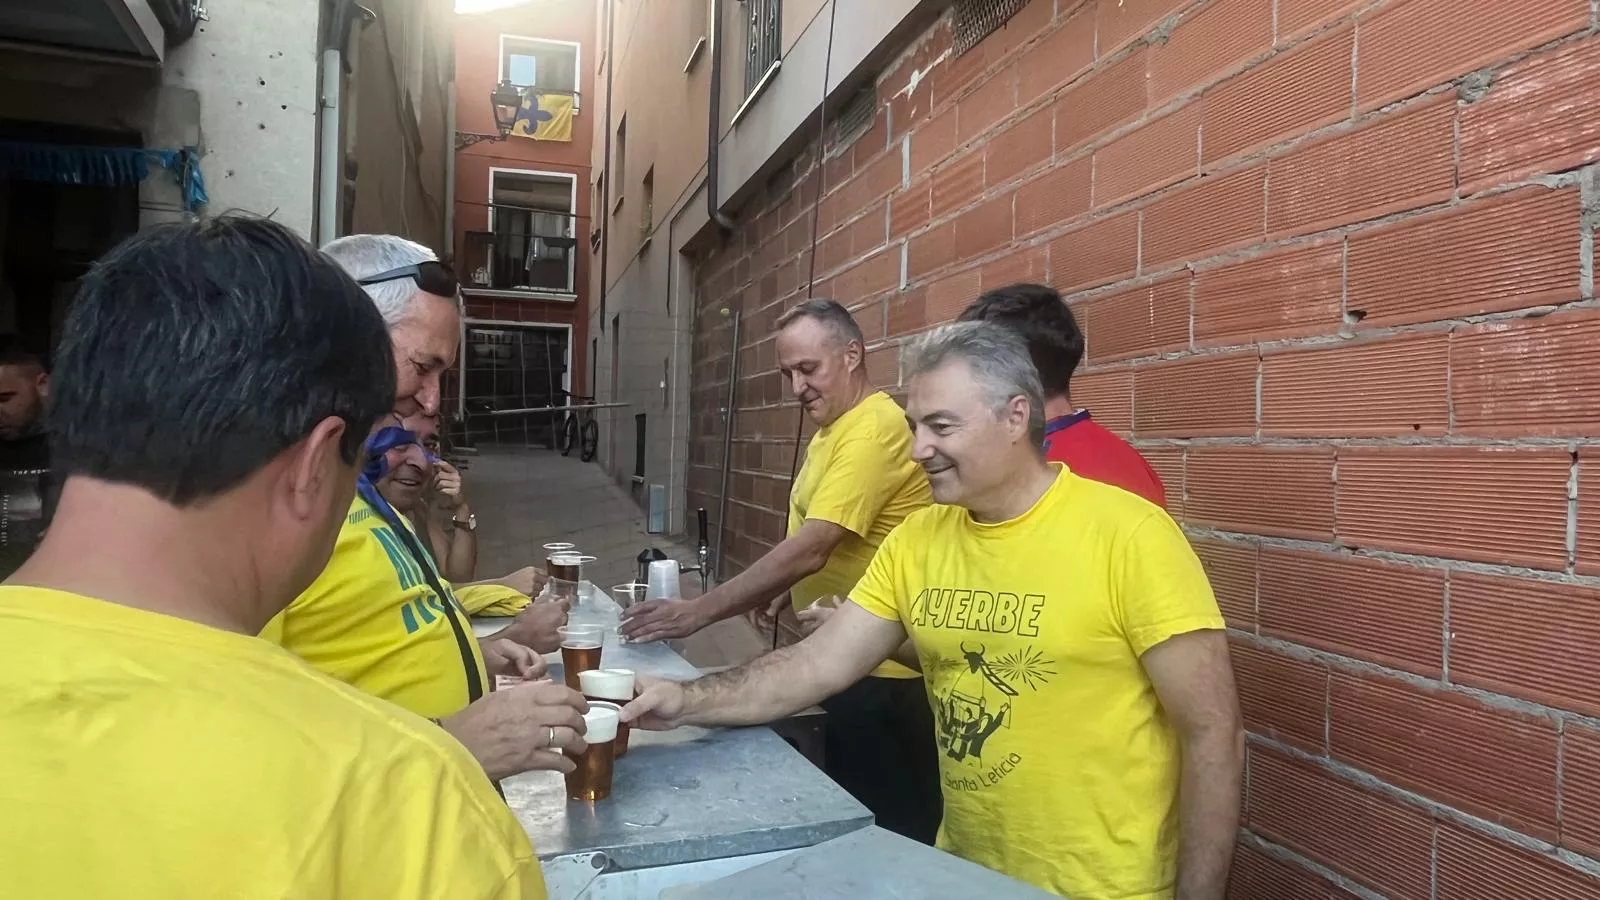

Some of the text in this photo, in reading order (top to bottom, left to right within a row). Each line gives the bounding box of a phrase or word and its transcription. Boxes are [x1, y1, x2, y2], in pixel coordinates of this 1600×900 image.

[910, 588, 1045, 637] AYERBE
[945, 752, 1022, 791] Santa Leticia
